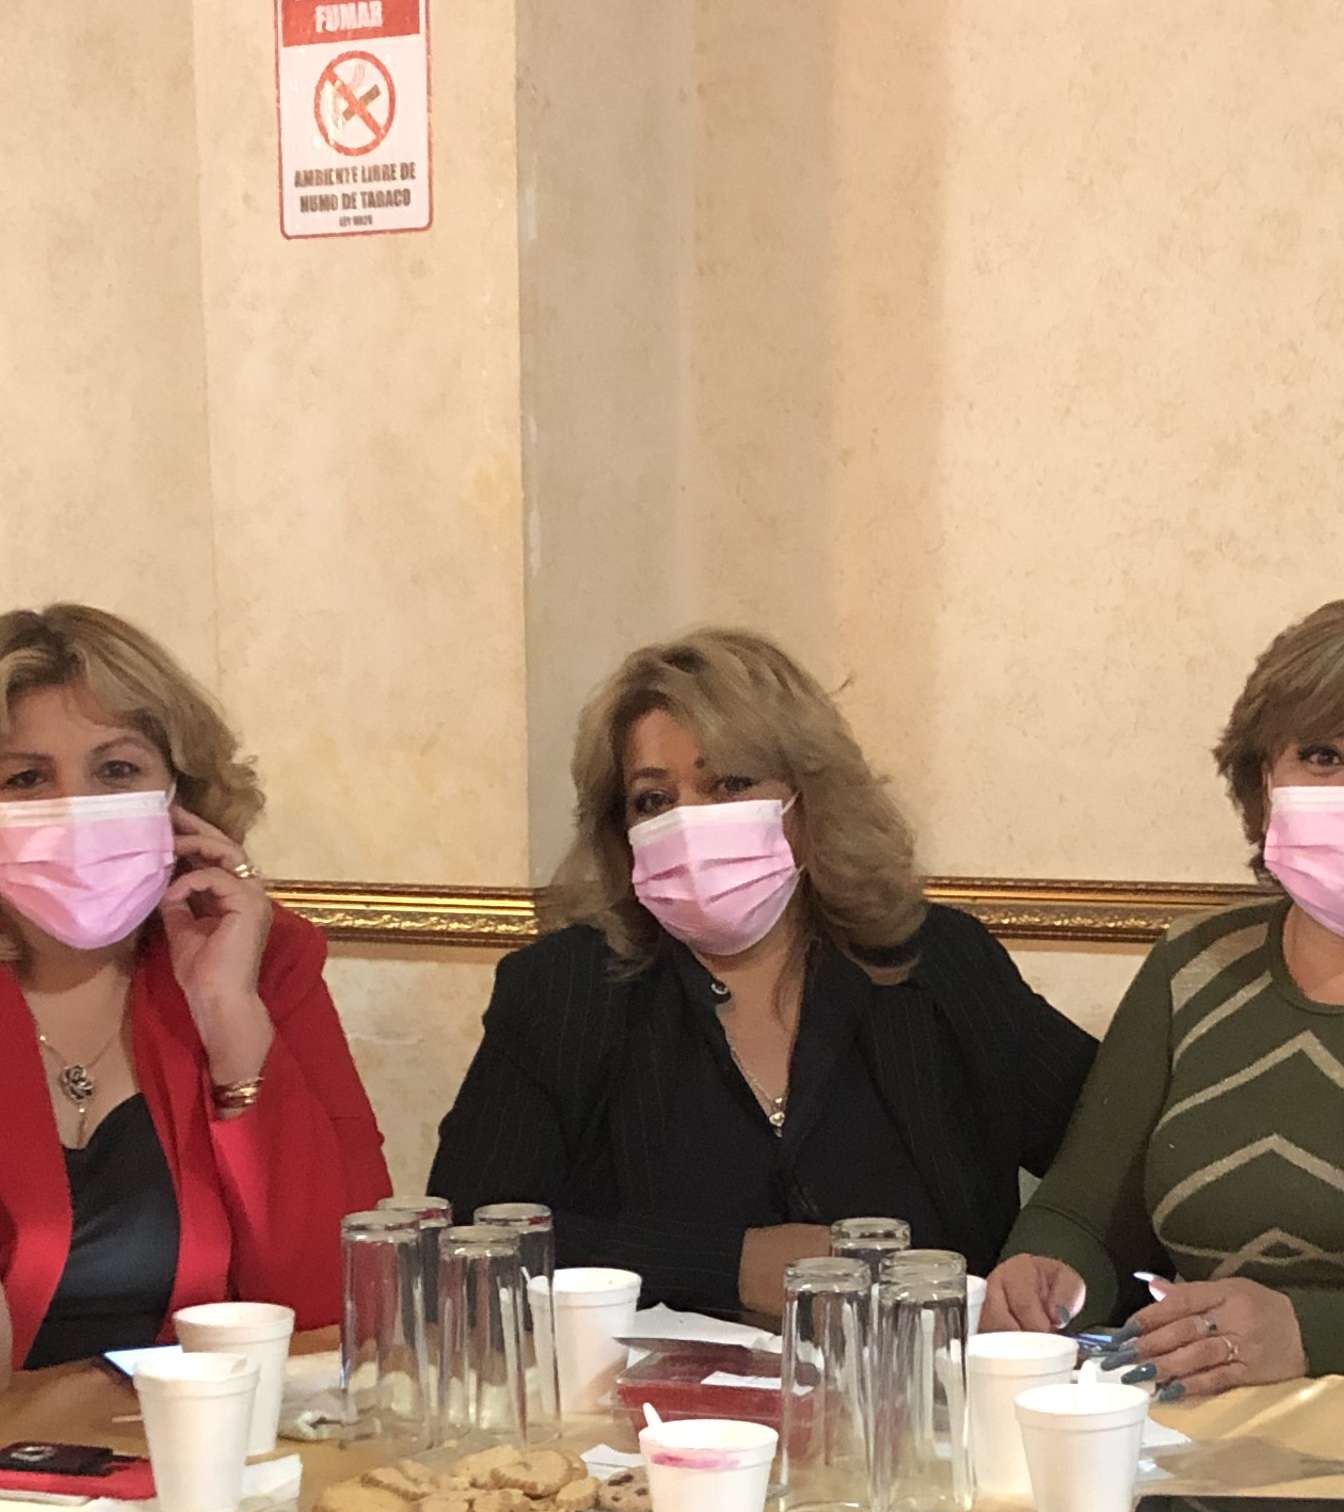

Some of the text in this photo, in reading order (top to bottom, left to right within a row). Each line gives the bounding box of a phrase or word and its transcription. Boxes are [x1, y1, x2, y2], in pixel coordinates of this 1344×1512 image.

[315, 1, 383, 33] FUMAR
[294, 162, 416, 188] AMBIENTE LIBRE DE
[341, 191, 357, 210] DE
[360, 188, 411, 209] TABACO
